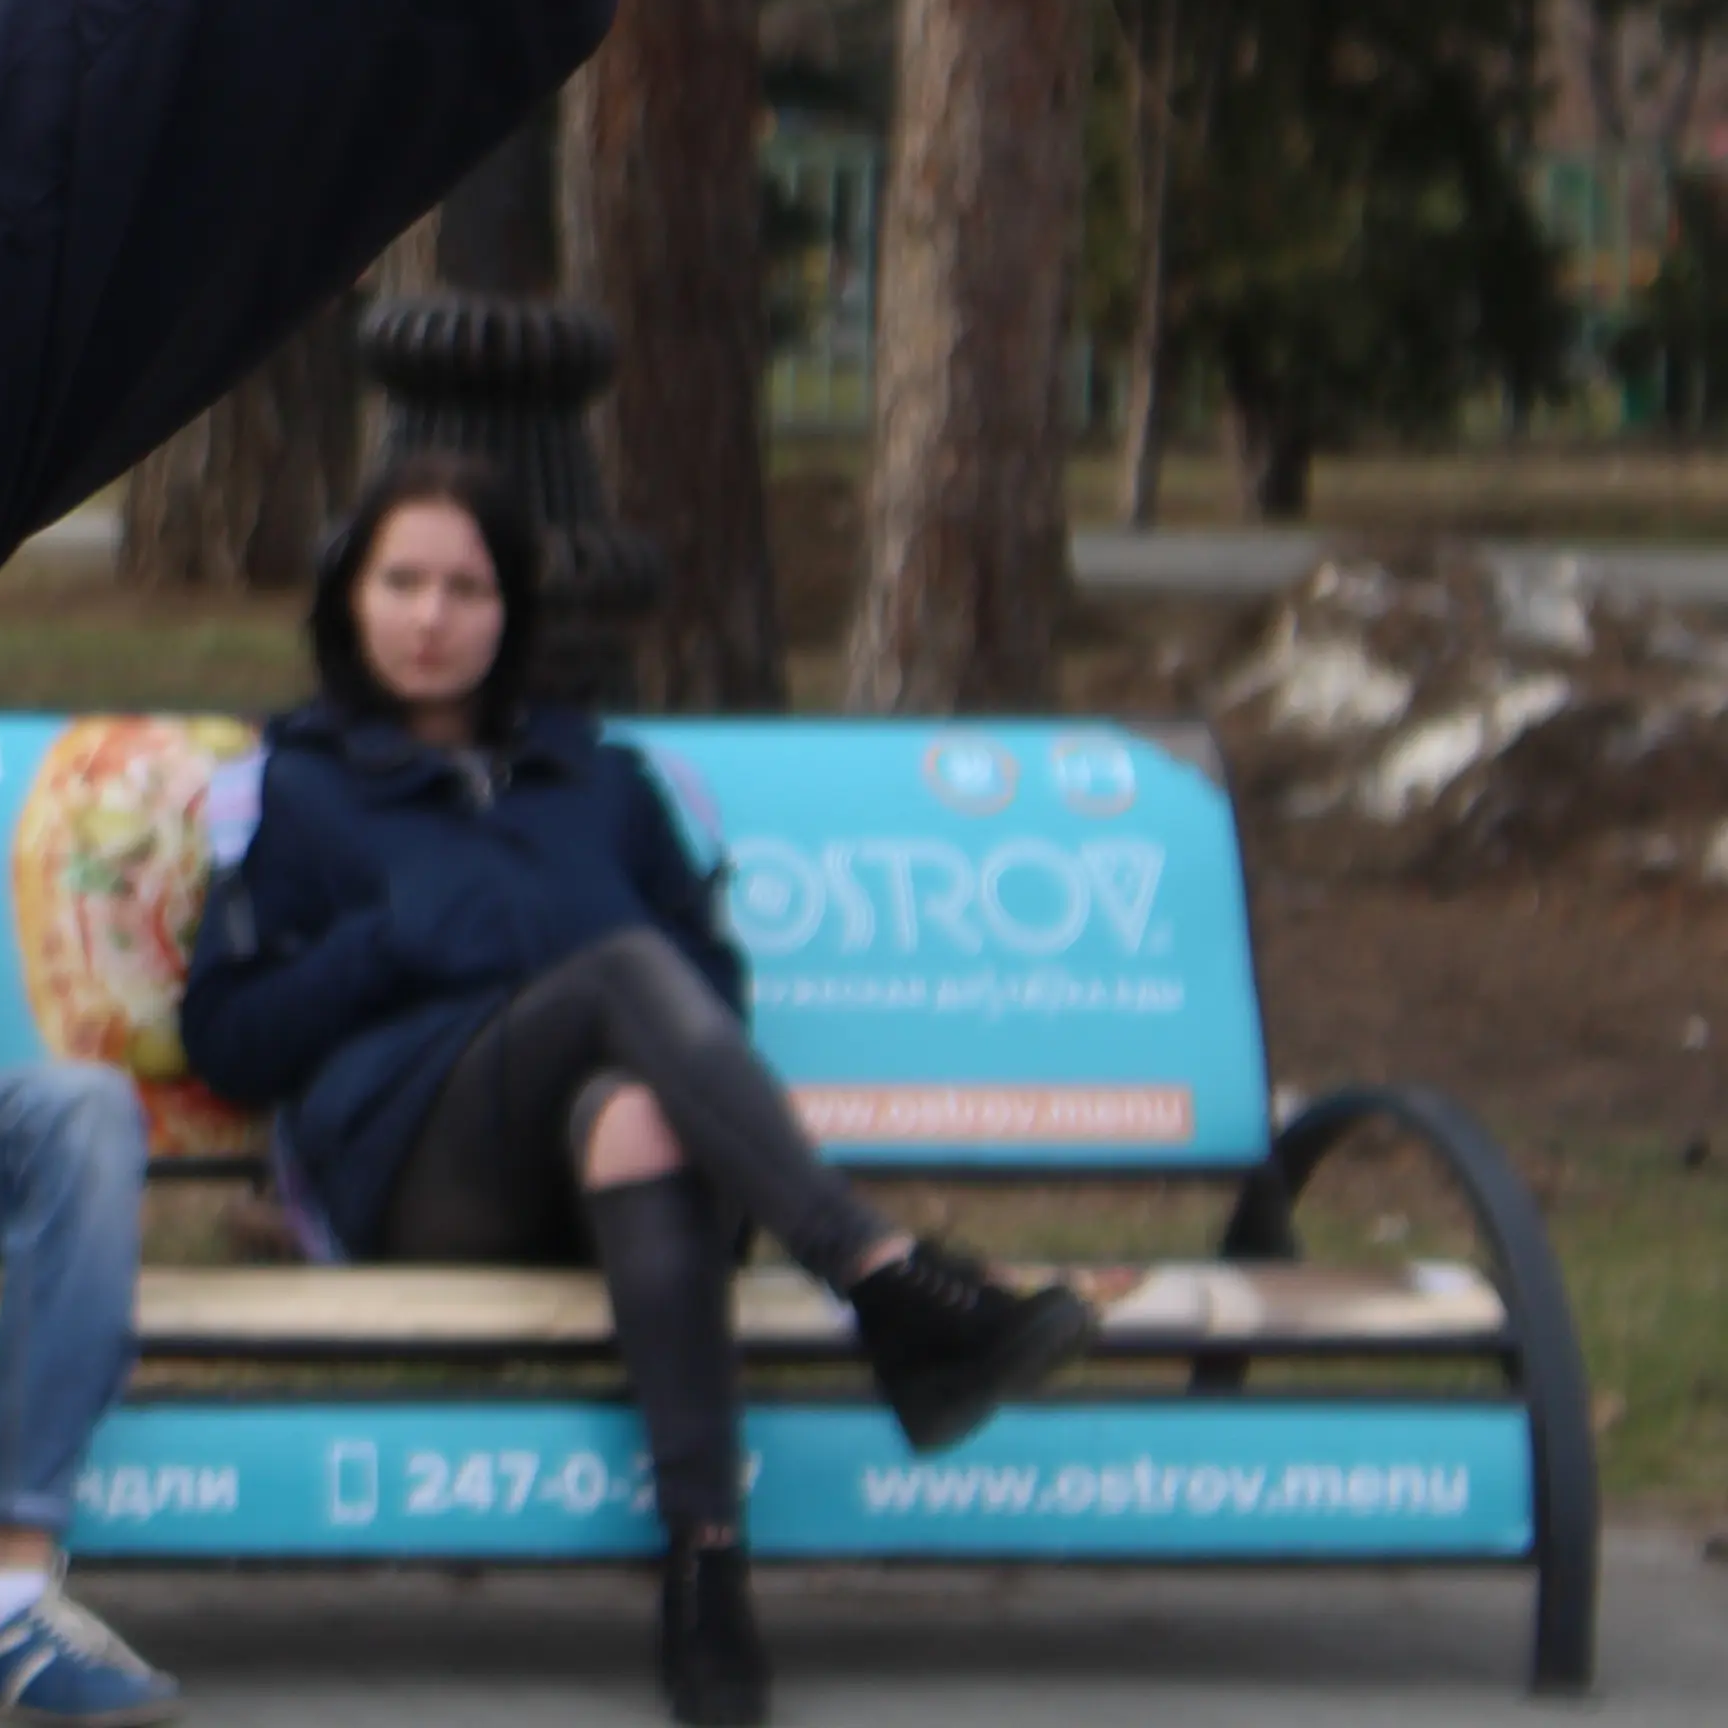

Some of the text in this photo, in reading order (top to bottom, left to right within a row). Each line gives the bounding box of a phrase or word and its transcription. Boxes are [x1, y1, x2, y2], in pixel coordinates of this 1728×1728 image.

[726, 835, 1169, 957] OSTROV
[796, 1086, 1186, 1135] ww.ostrov.menu
[862, 1451, 1471, 1516] www.ostrov.menu
